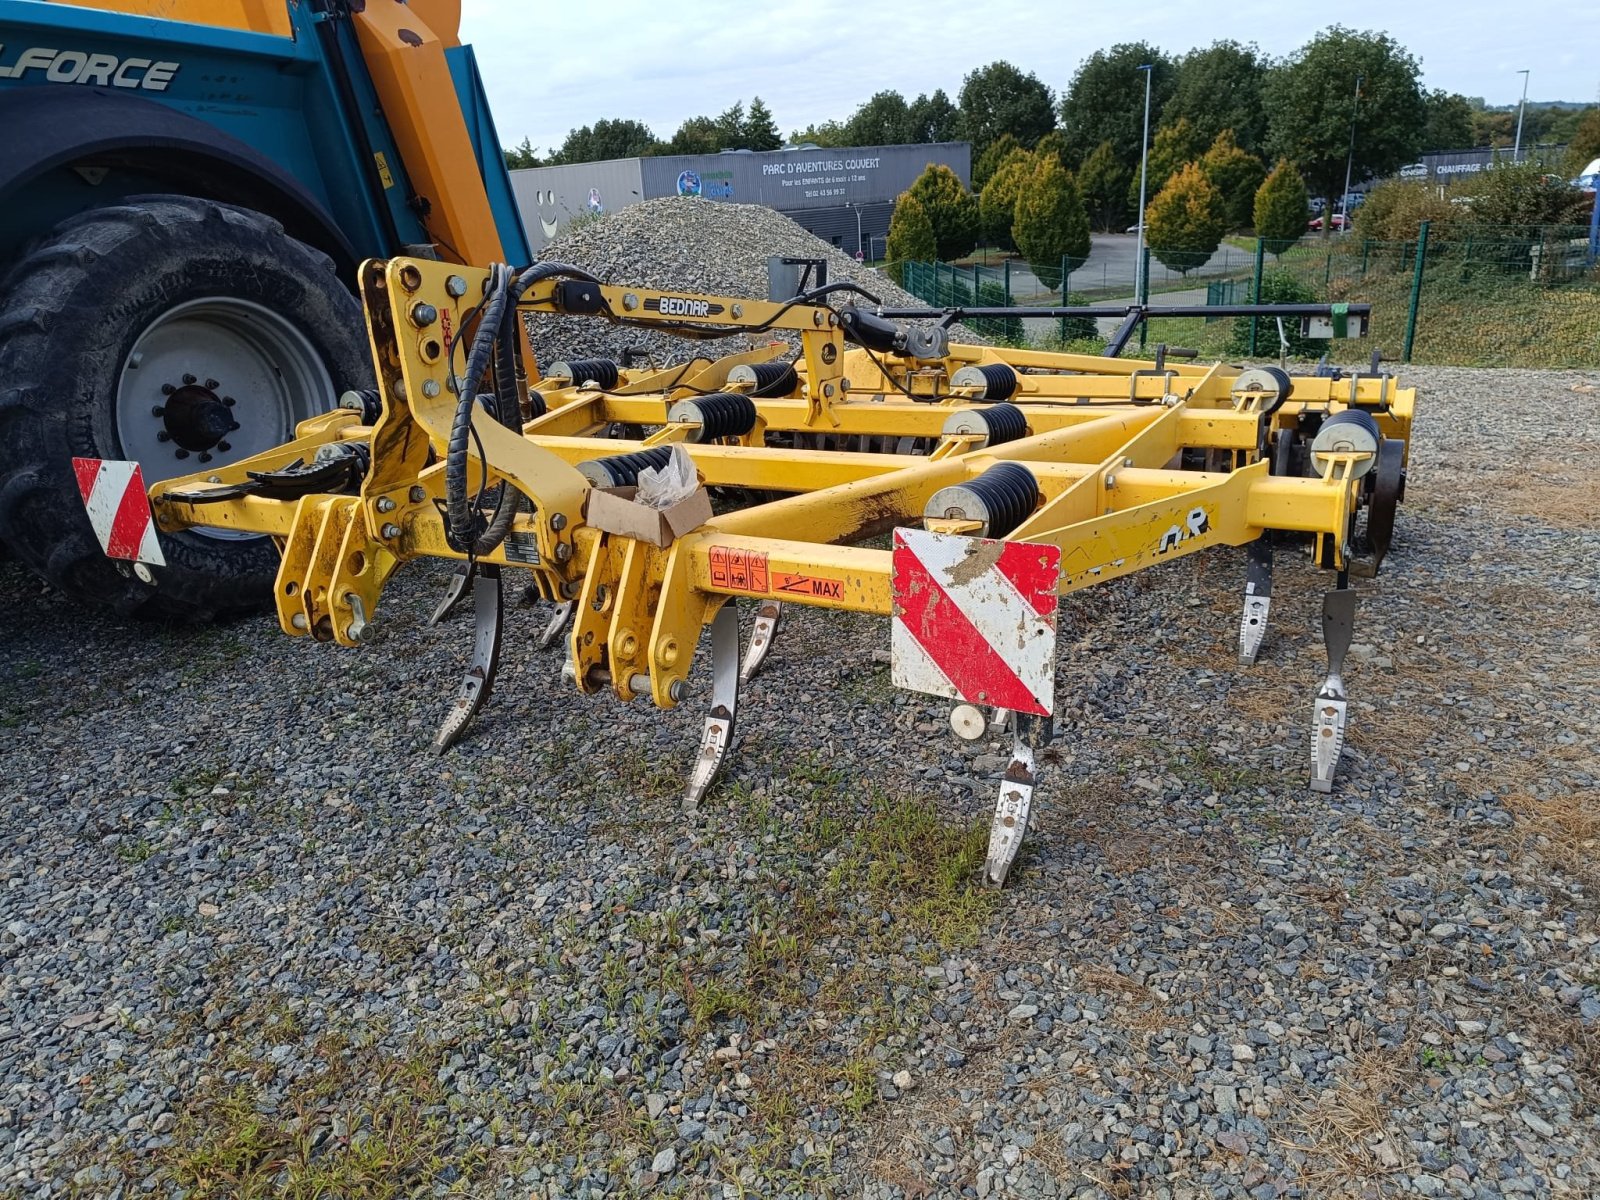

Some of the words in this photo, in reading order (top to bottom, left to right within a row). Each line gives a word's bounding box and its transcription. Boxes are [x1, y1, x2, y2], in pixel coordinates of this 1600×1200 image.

[763, 163, 786, 175] PARC
[787, 160, 844, 174] D'AVENTURES
[845, 158, 880, 170] COUVERT
[1436, 163, 1481, 174] CHAUFFAGE
[781, 179, 793, 187] Pour
[794, 178, 802, 186] les
[802, 177, 824, 185] ENFANTS
[825, 176, 831, 184] de
[851, 174, 857, 182] 12
[659, 296, 709, 317] BEDNAR
[812, 580, 840, 598] MAX
